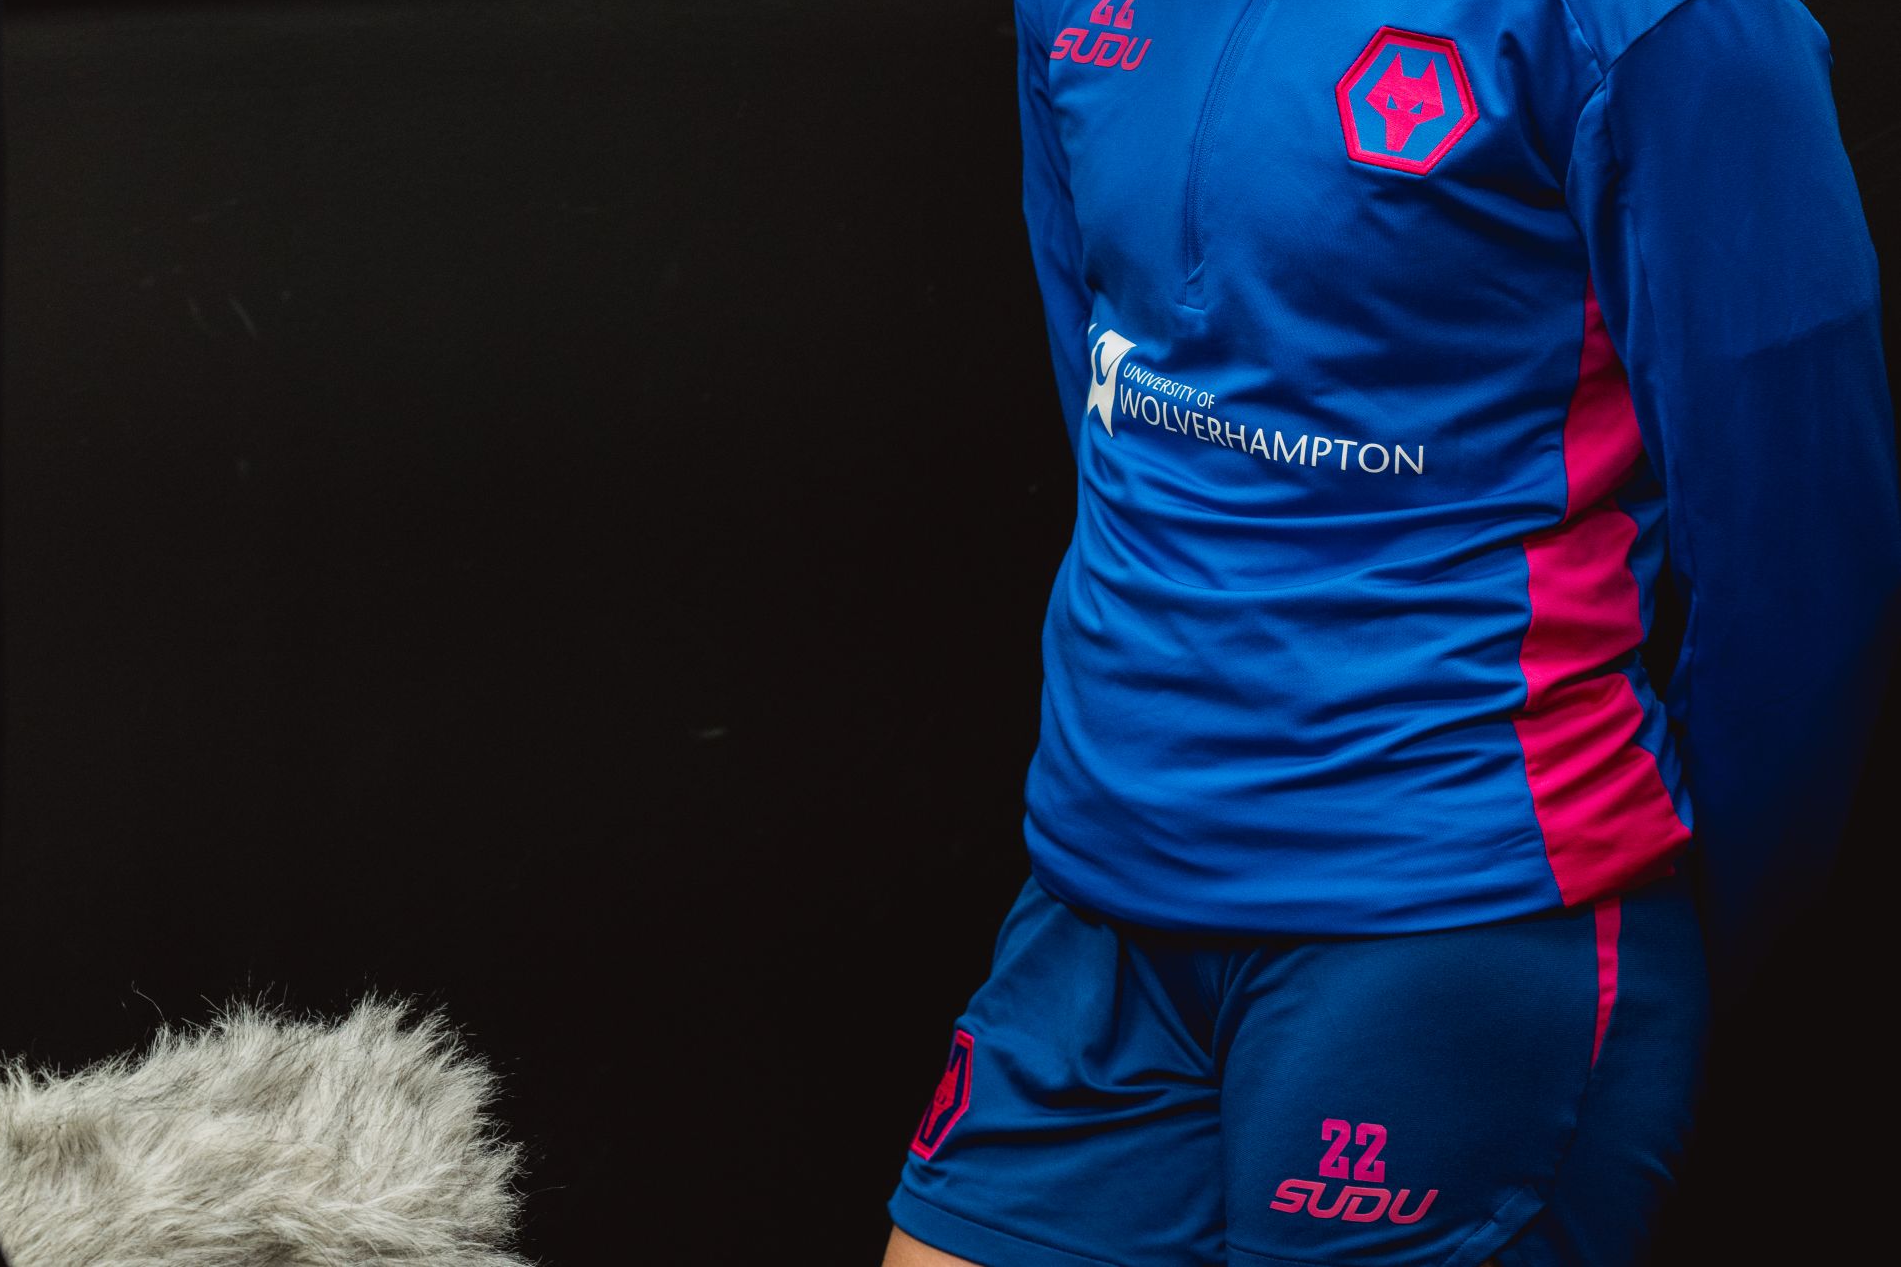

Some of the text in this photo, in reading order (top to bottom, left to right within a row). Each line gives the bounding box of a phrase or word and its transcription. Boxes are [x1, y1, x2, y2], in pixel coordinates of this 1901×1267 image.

[1049, 27, 1153, 72] SUDU
[1123, 362, 1216, 410] UNIVERSITY OF
[1120, 387, 1424, 476] WOLVERHAMPTON
[1320, 1118, 1388, 1183] 22
[1269, 1179, 1439, 1225] SUDU
